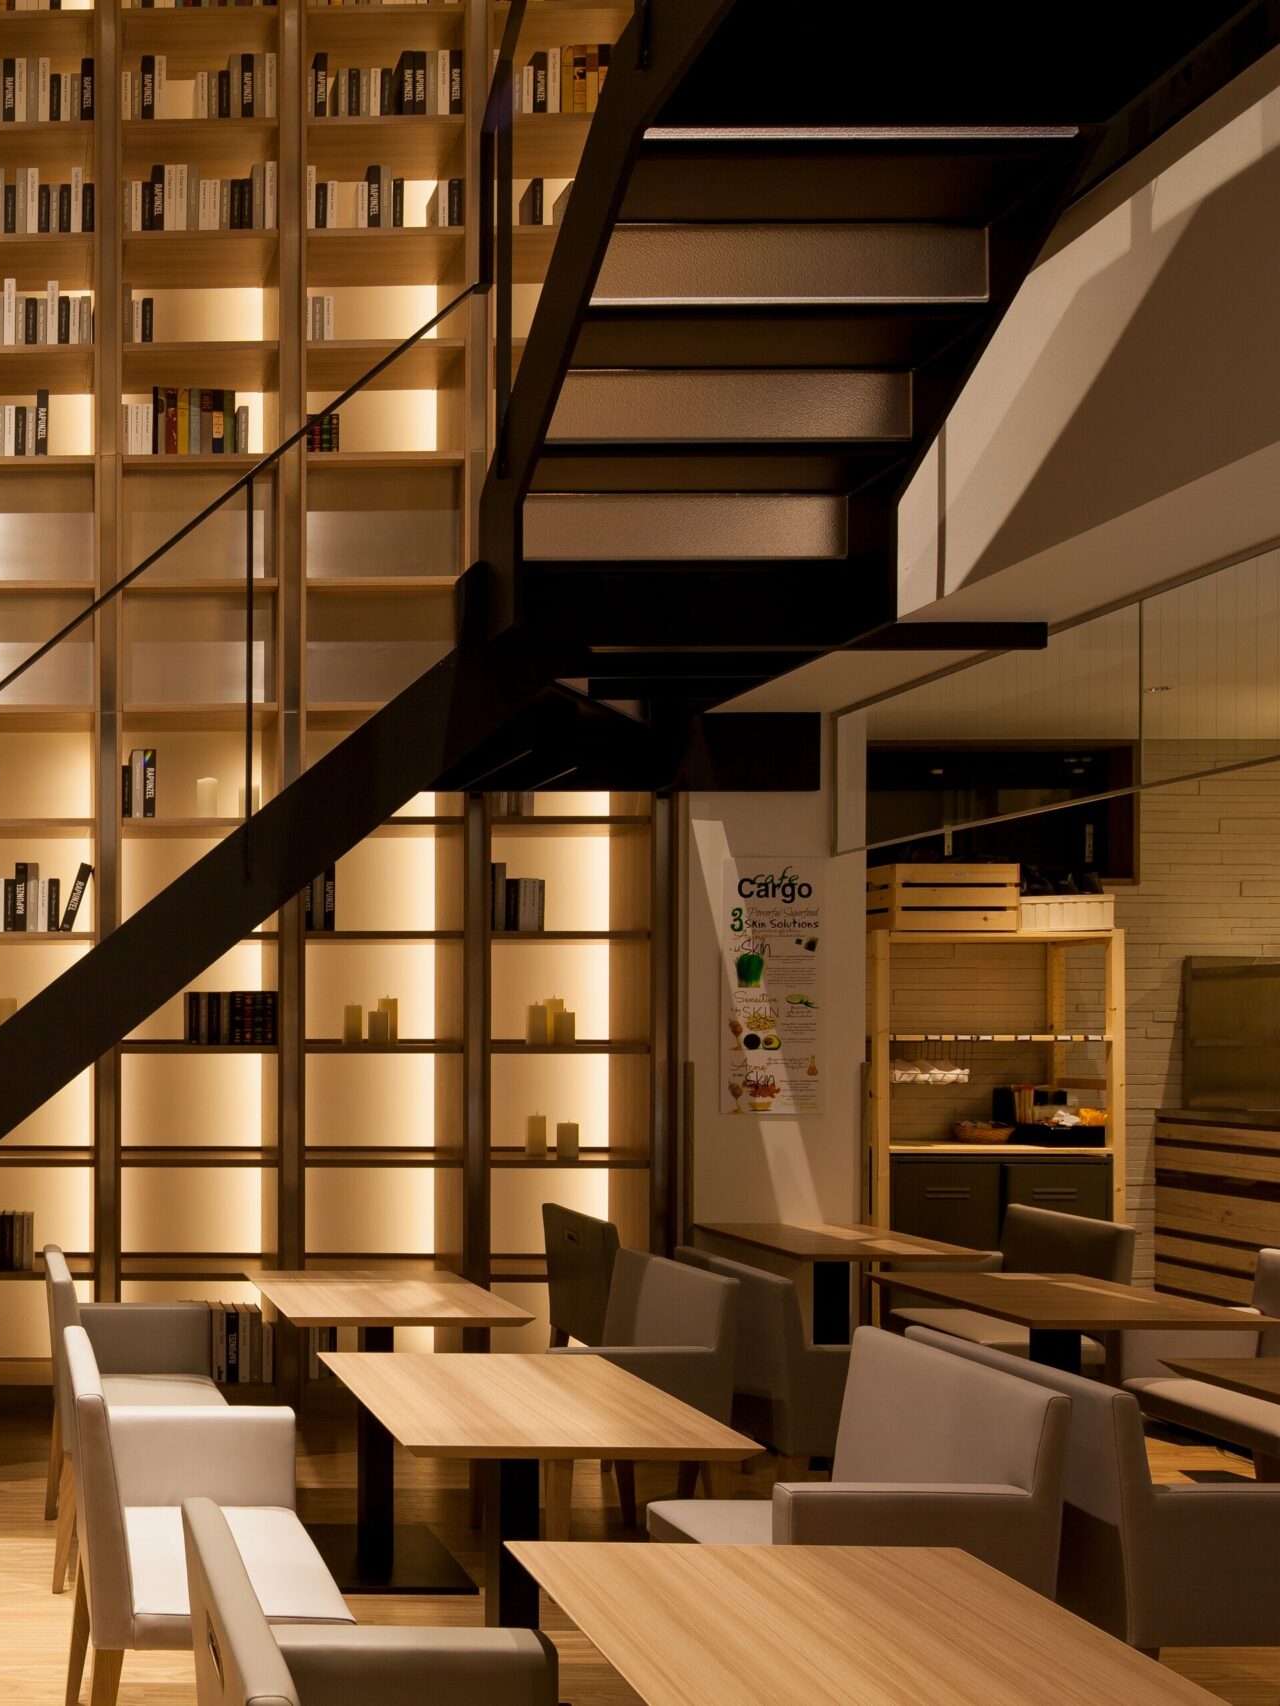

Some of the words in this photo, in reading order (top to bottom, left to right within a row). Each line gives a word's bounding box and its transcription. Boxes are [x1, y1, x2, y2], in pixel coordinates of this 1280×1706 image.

[144, 75, 152, 105] RAPUNZEL
[416, 70, 424, 101] RAPUNZEL
[452, 69, 460, 100] RAPUNZEL
[537, 71, 545, 102] RAPUNZEL
[370, 184, 378, 215] RAPUNZEL
[38, 408, 46, 438] RAPUNZEL
[67, 881, 85, 911] RAPUNZEL
[737, 878, 813, 903] Cargo
[730, 907, 743, 932] 3
[744, 918, 767, 929] Skin
[770, 918, 820, 929] Solutions
[747, 907, 782, 919] Powerful
[733, 990, 779, 1003] Sensitive
[742, 1006, 780, 1019] SKIN
